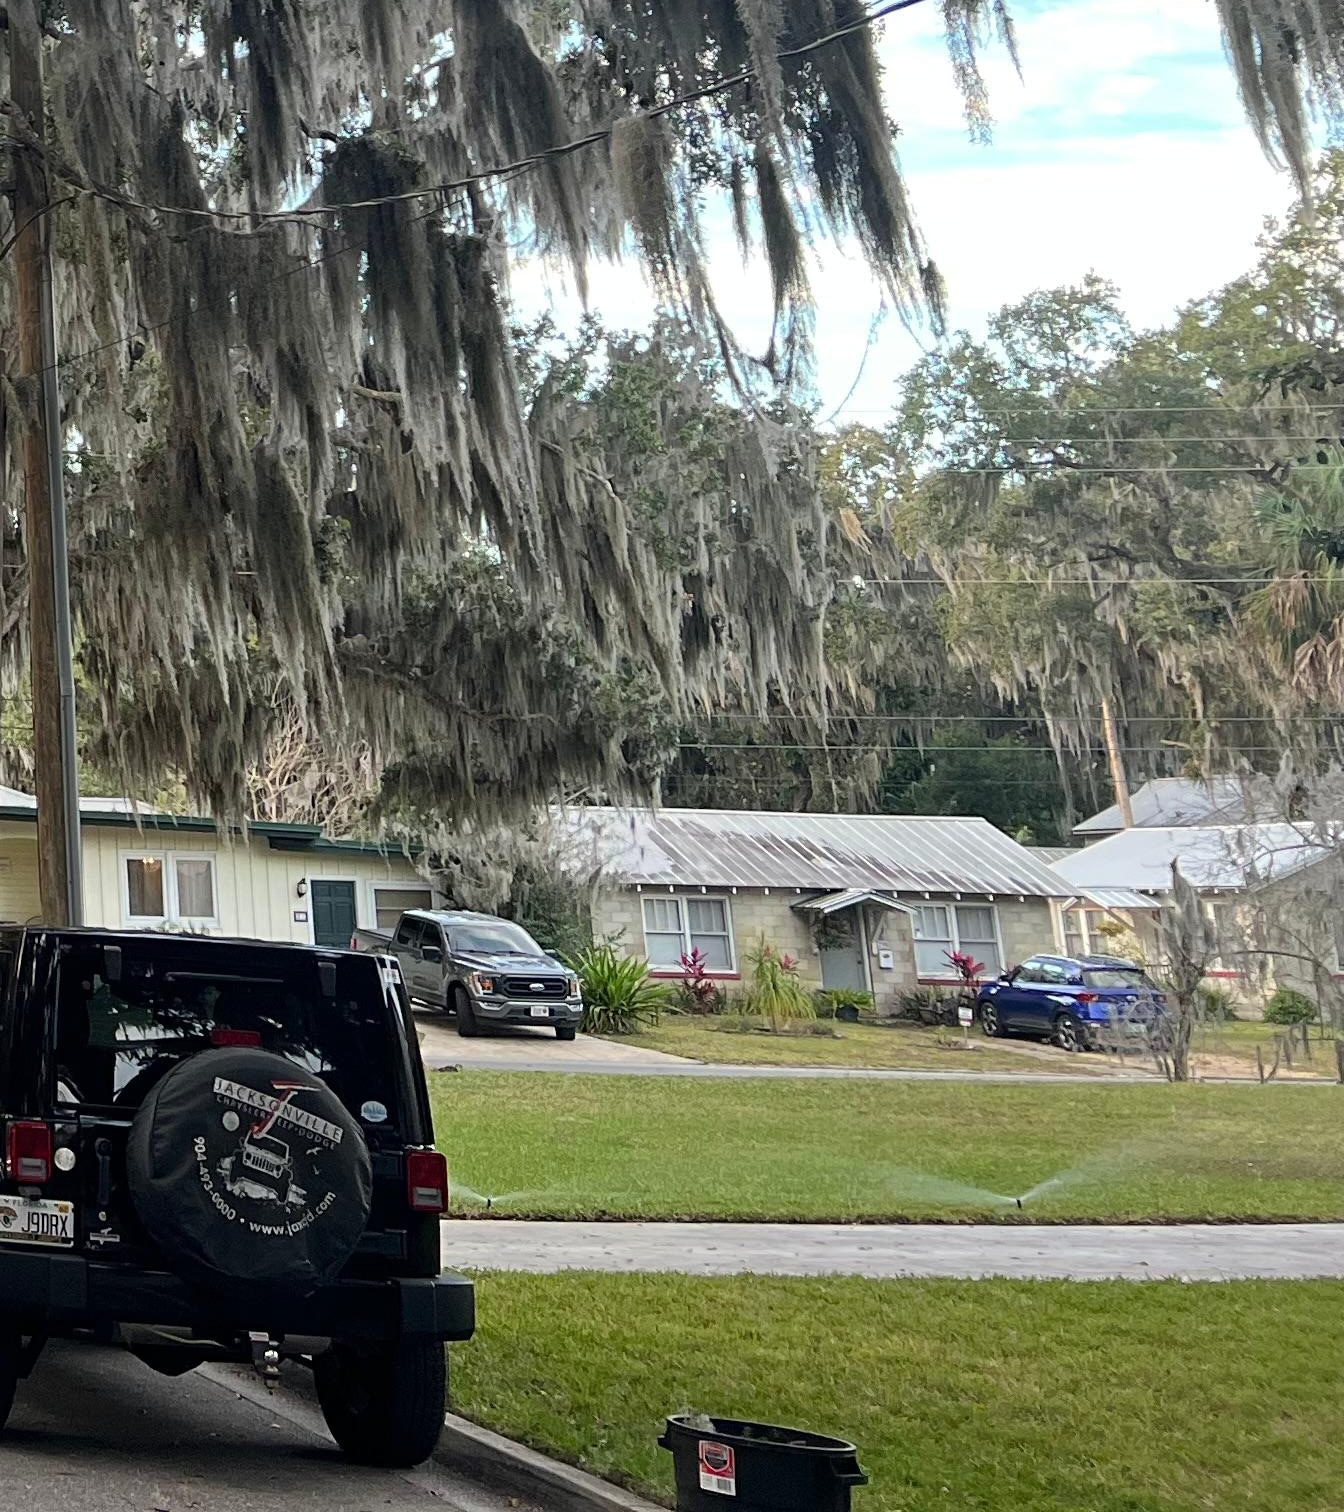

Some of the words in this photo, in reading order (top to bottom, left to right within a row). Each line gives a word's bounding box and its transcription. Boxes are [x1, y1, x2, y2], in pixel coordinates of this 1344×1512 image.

[214, 1078, 343, 1142] JACKSONVILLE
[193, 1136, 236, 1220] 904-493-0000
[21, 1211, 68, 1237] J9DRX
